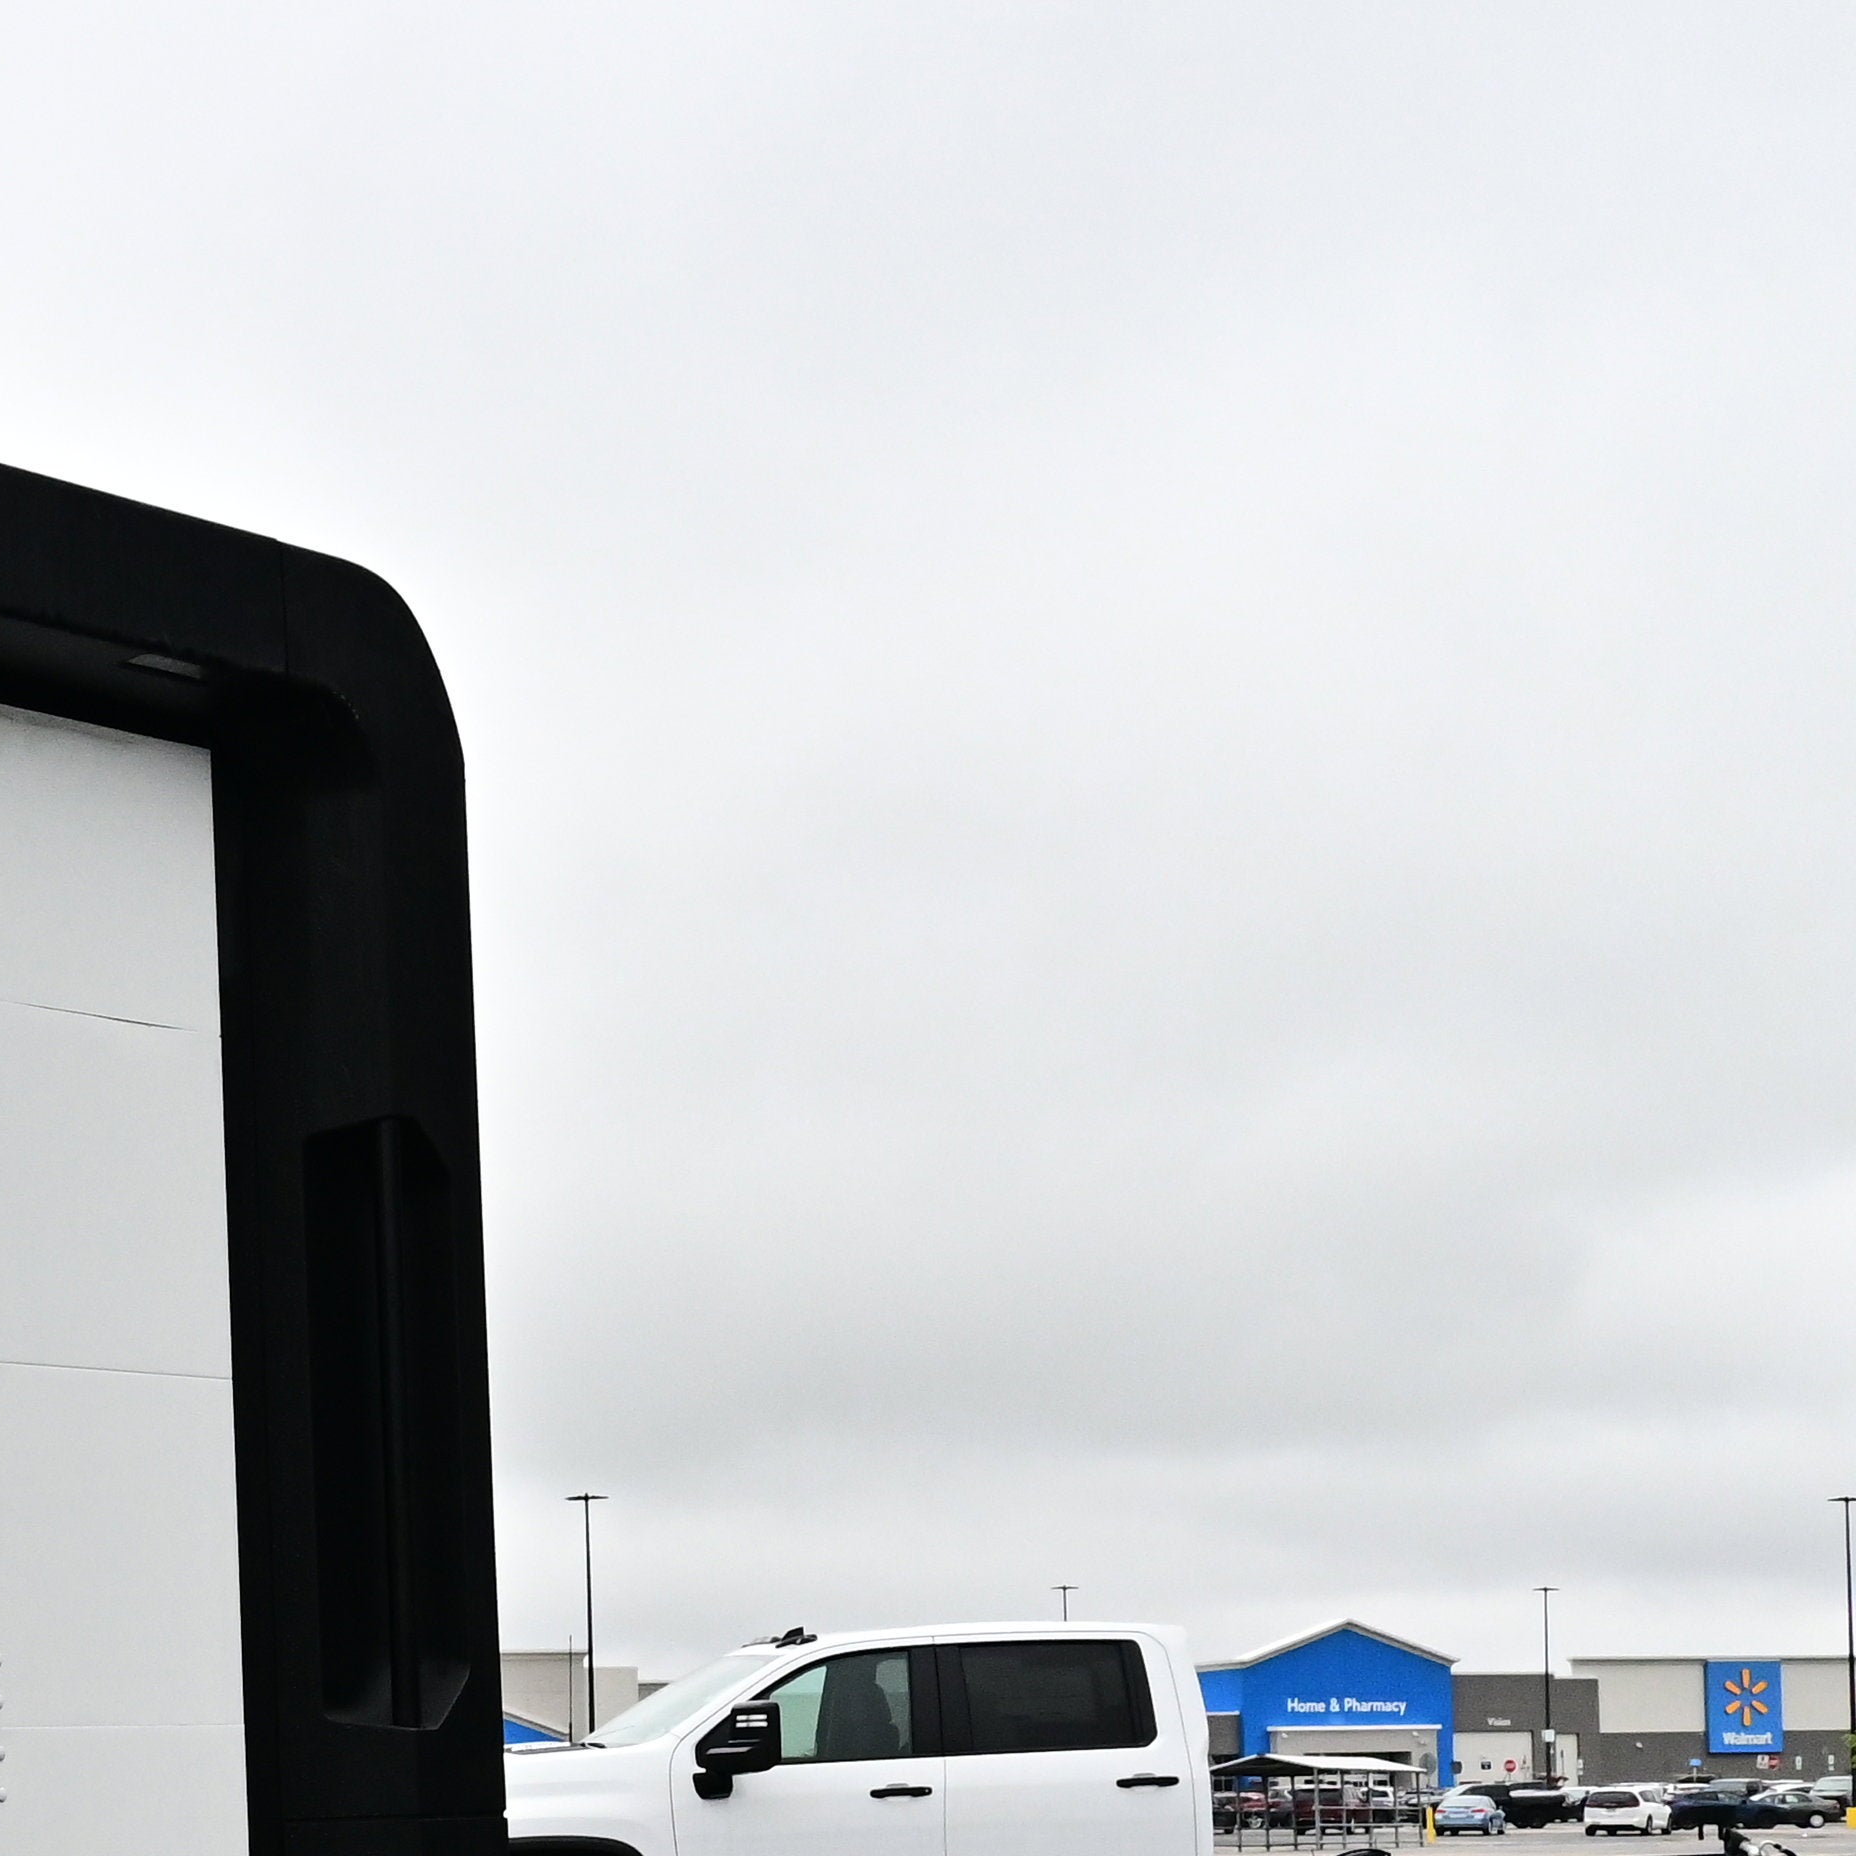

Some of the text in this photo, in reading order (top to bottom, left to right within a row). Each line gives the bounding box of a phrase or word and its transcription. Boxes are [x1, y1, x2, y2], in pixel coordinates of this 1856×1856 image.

[1287, 1697, 1407, 1716] Home & Pharmacy
[1722, 1731, 1774, 1745] Walmart
